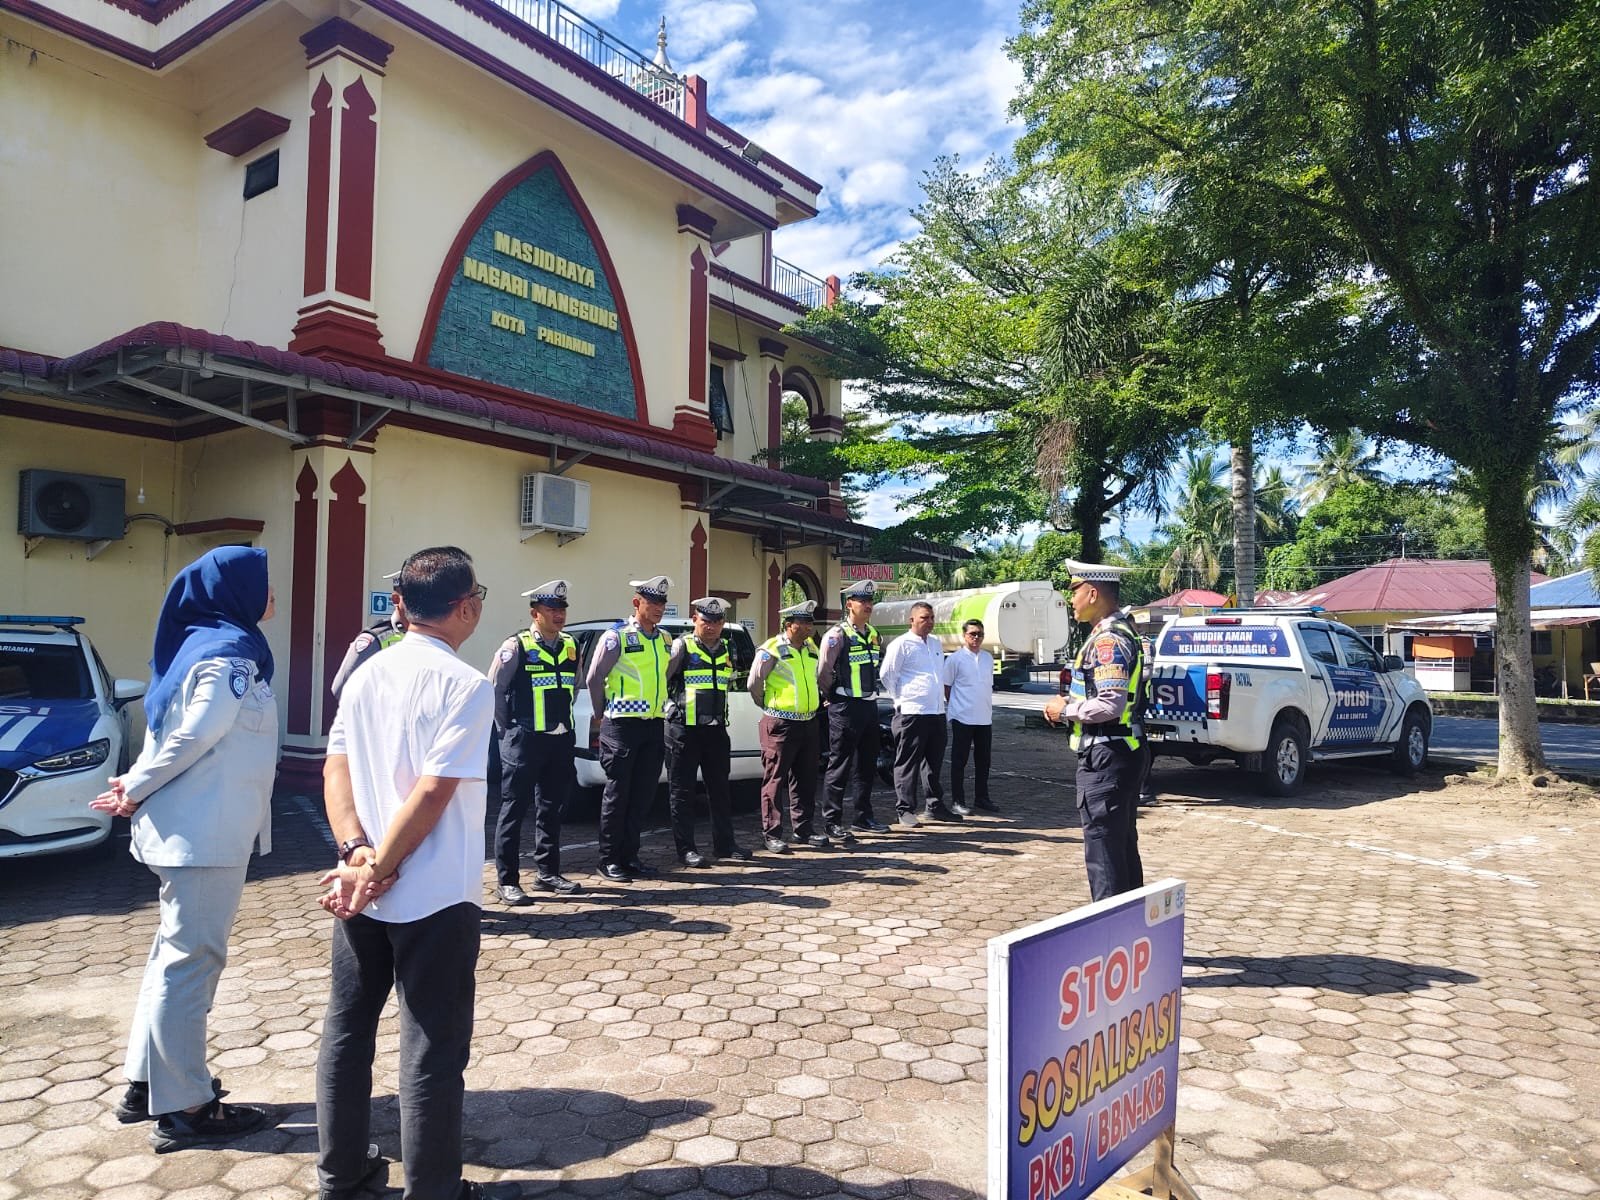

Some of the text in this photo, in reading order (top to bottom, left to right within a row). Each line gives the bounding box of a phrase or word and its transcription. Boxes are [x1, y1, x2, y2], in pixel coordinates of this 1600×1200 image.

[463, 256, 618, 332] NAGARI MANGGUNG
[555, 255, 596, 289] RAYA
[491, 310, 596, 358] KOTA PARIAMAN
[1178, 643, 1269, 655] KELUARGA BAHAGIA
[1193, 631, 1253, 642] MUDIK AMAN
[1337, 690, 1370, 707] POLISI
[1058, 937, 1152, 1031] STOP
[1018, 988, 1178, 1147] SOSIALISASI
[1029, 1131, 1076, 1200] PKB
[1097, 1066, 1166, 1162] BBN-KB
